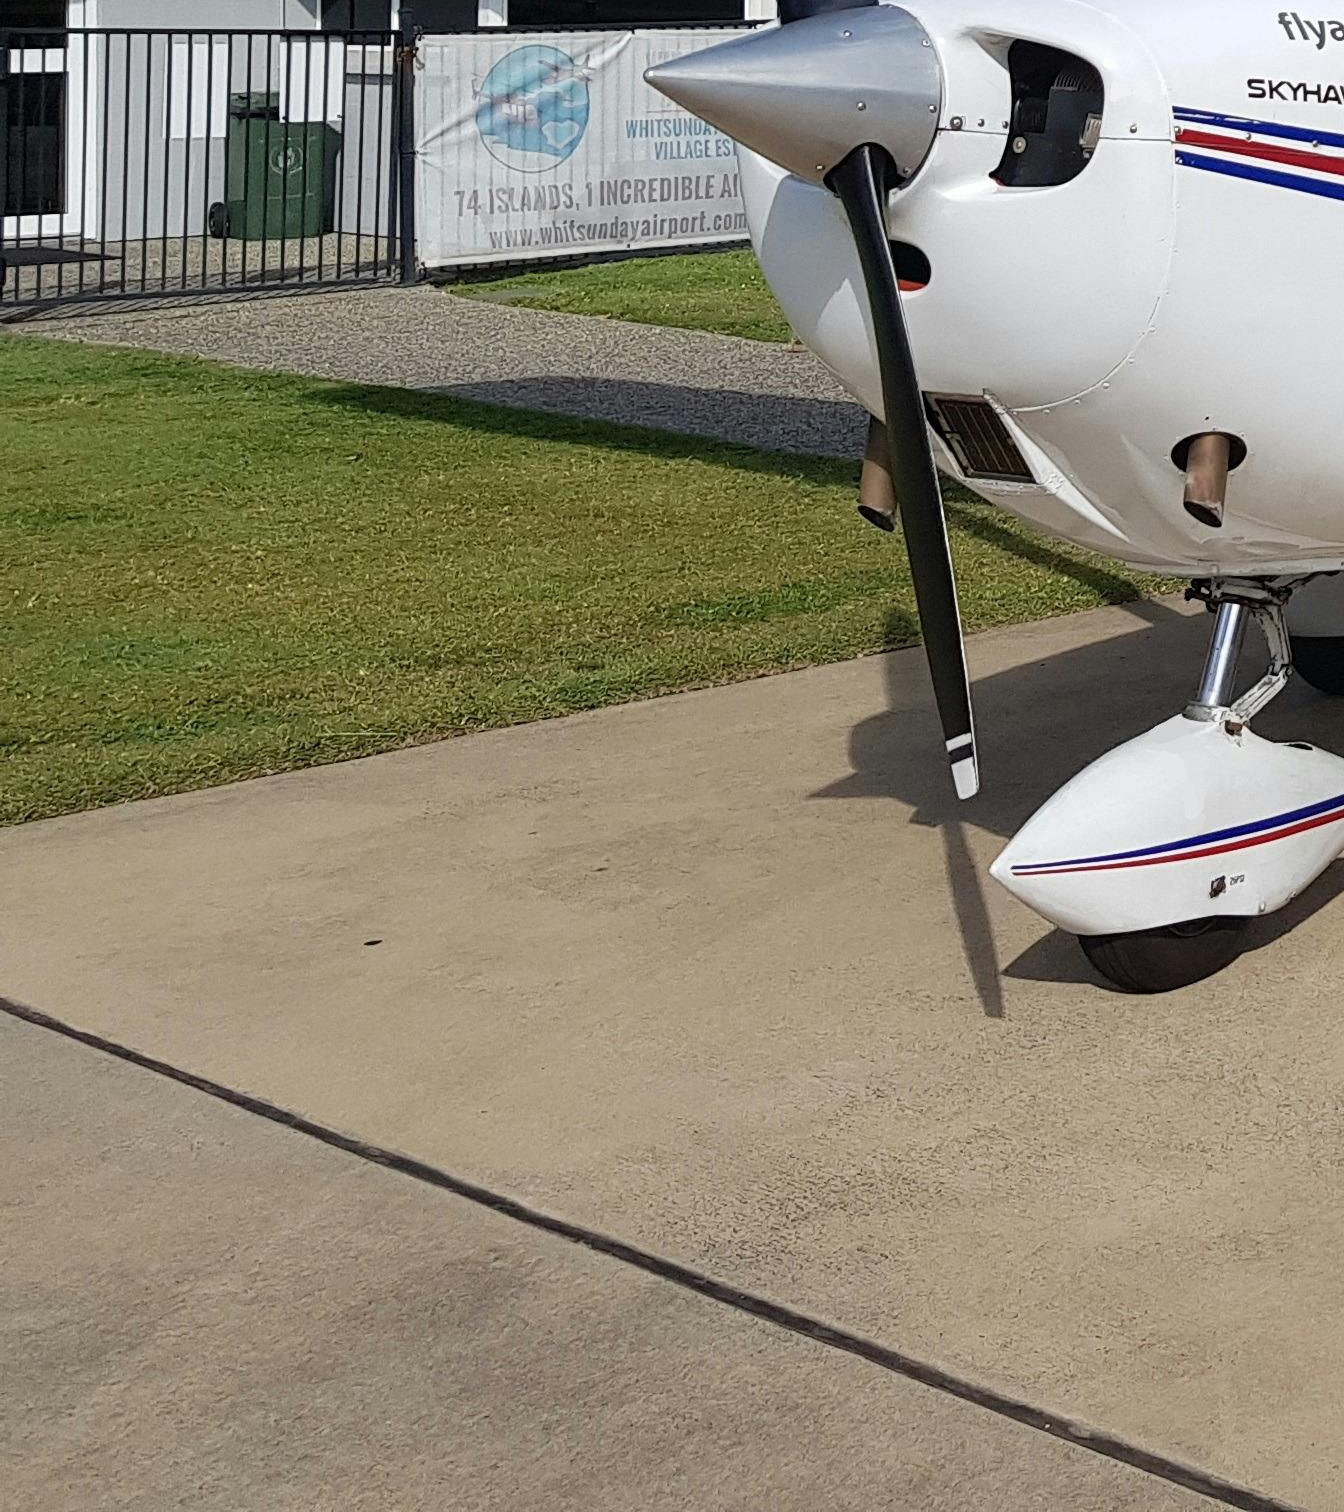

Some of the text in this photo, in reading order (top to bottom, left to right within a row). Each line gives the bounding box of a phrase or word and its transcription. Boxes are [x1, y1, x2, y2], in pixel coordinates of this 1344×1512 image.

[625, 117, 719, 139] WHITSUNDA
[654, 140, 712, 161] VILLAGE
[454, 190, 481, 217] 74
[488, 182, 580, 215] ISLANDS,
[585, 181, 594, 208] 1
[600, 174, 714, 207] INCREDIBLE
[489, 209, 748, 249] www.whitsundayairport.com
